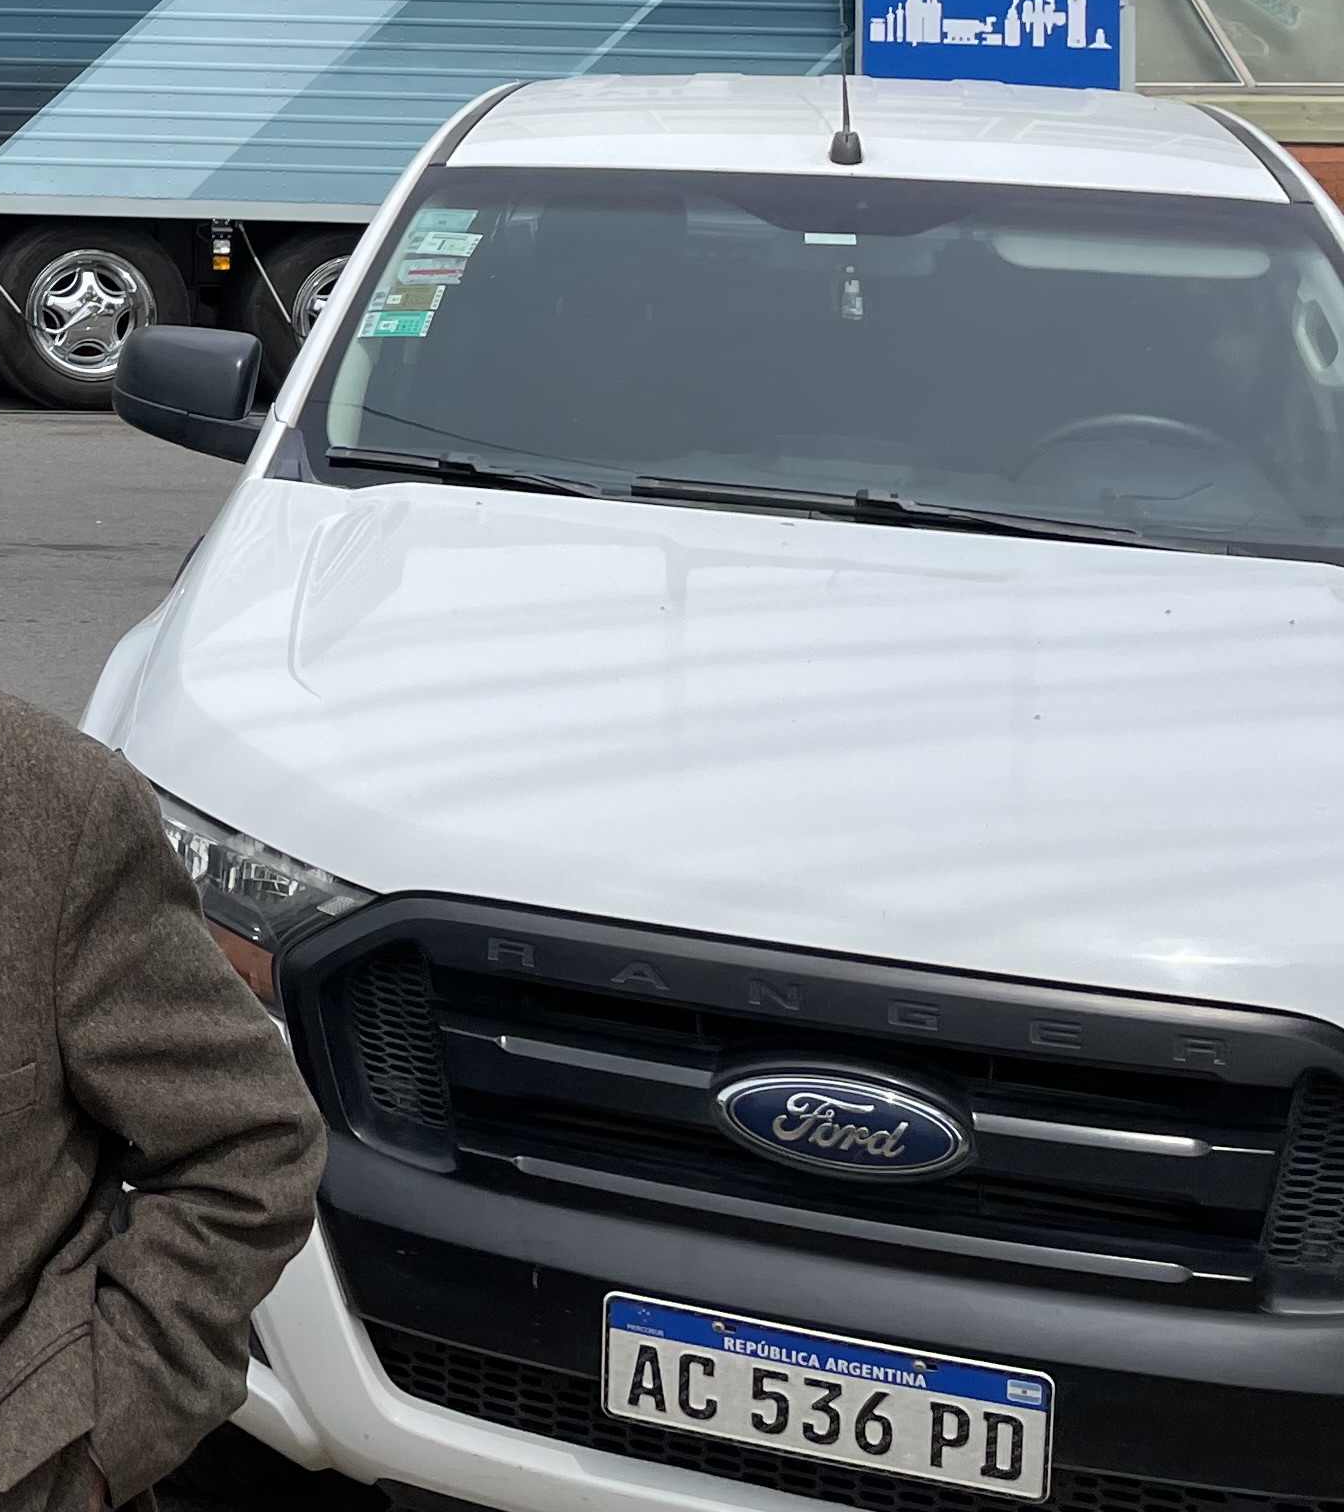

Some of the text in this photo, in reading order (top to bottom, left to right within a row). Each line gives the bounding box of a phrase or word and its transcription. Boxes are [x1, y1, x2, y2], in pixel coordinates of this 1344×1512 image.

[486, 935, 1231, 1067] RANGER
[771, 1091, 911, 1159] Ford
[722, 1335, 927, 1389] REPÚBLICA ARGENTINA
[627, 1344, 1024, 1481] AC 536 PD
